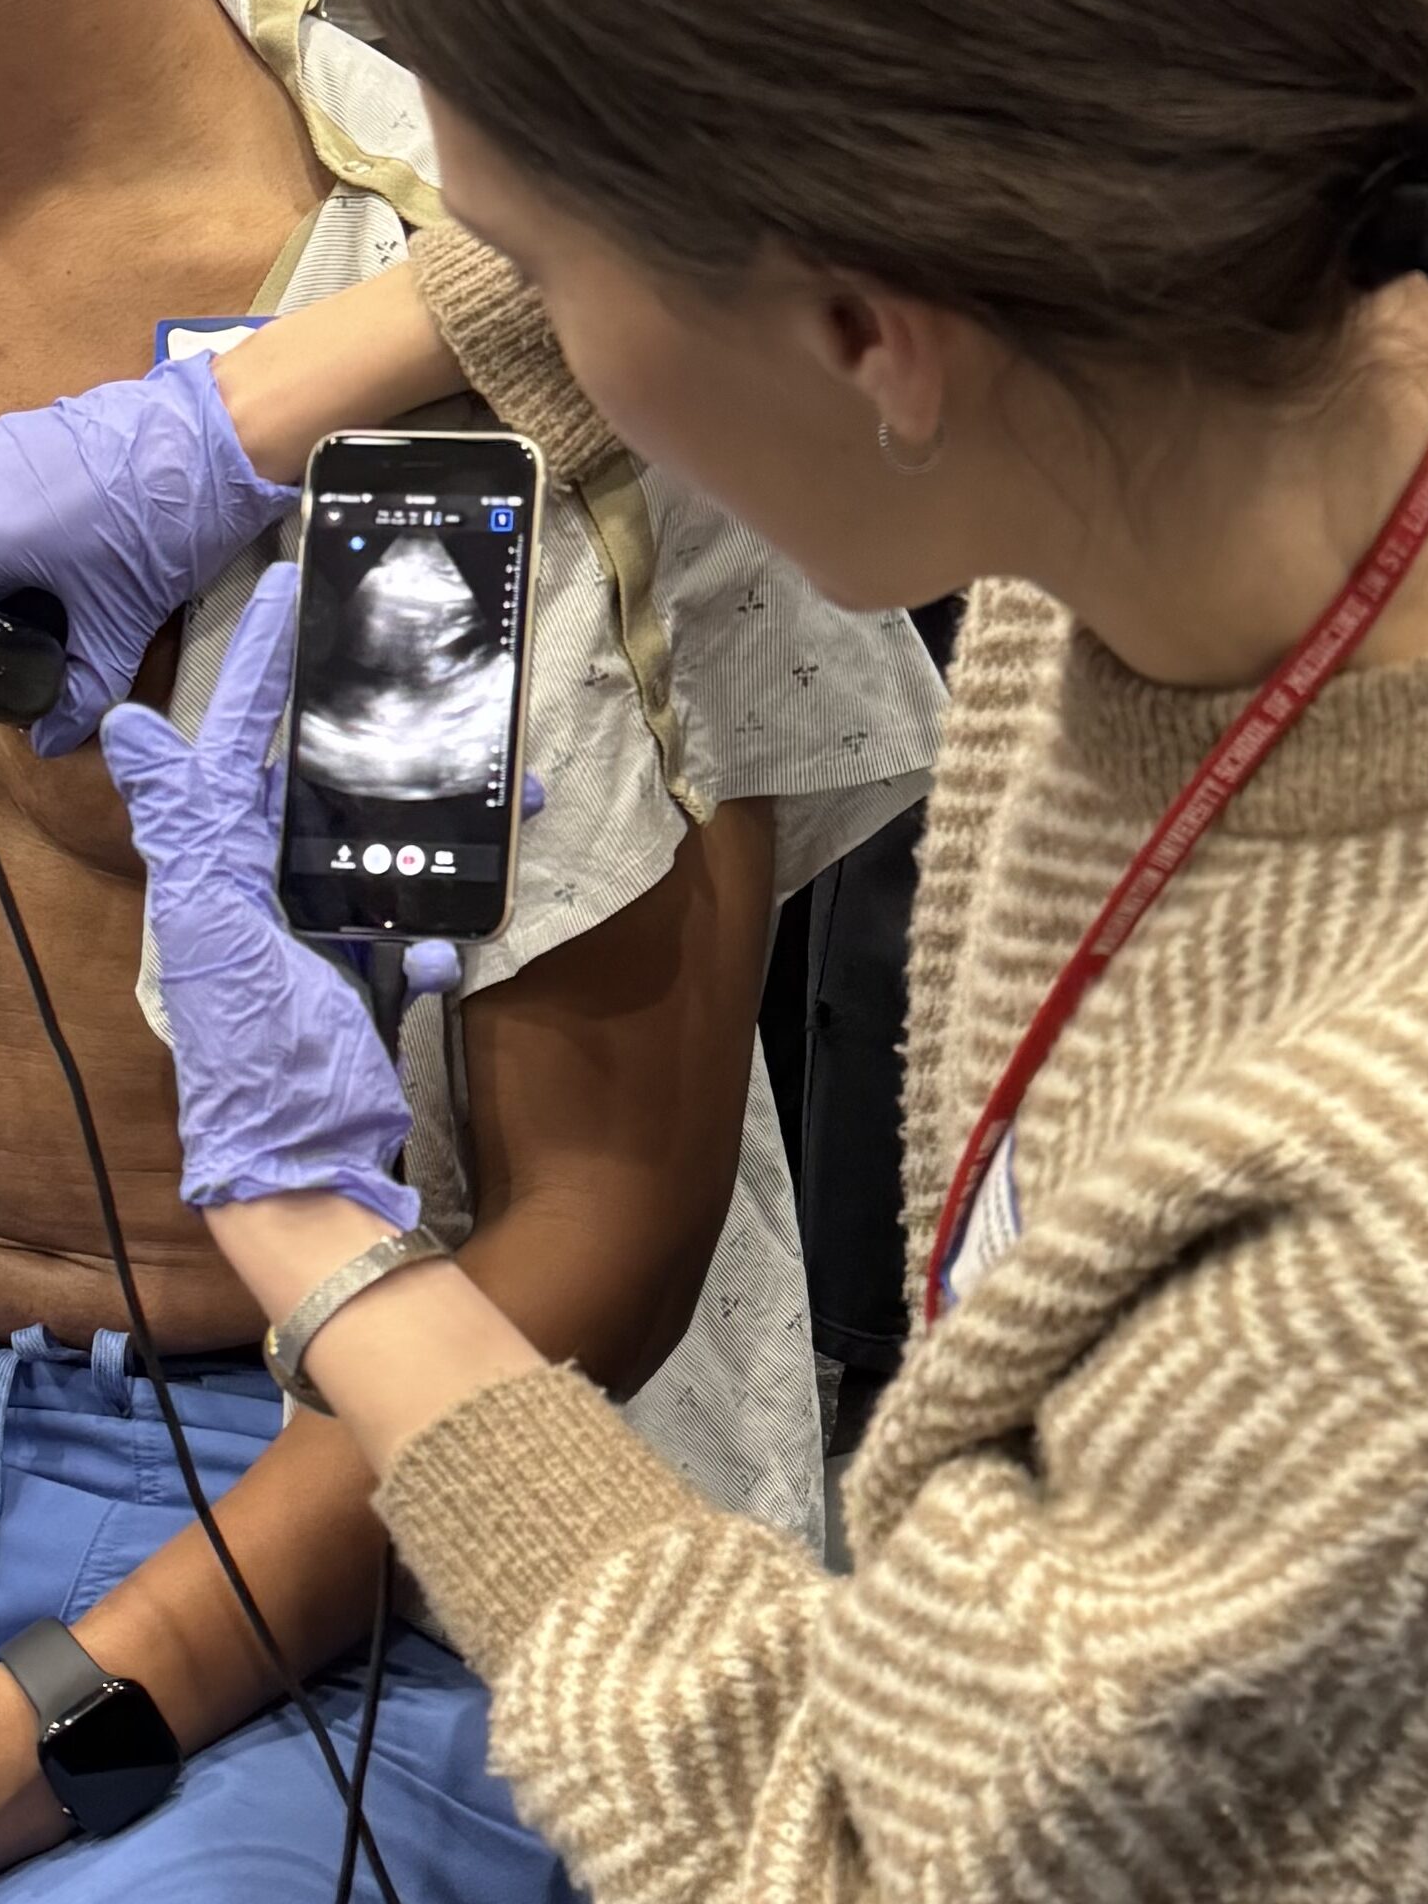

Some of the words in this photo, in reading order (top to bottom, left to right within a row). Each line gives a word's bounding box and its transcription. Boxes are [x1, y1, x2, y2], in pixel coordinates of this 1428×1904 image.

[1149, 775, 1228, 873] UNIVERSITY
[1211, 717, 1278, 784] SCHOOL
[1262, 688, 1294, 723] OF
[1284, 594, 1370, 696] MEDICINE
